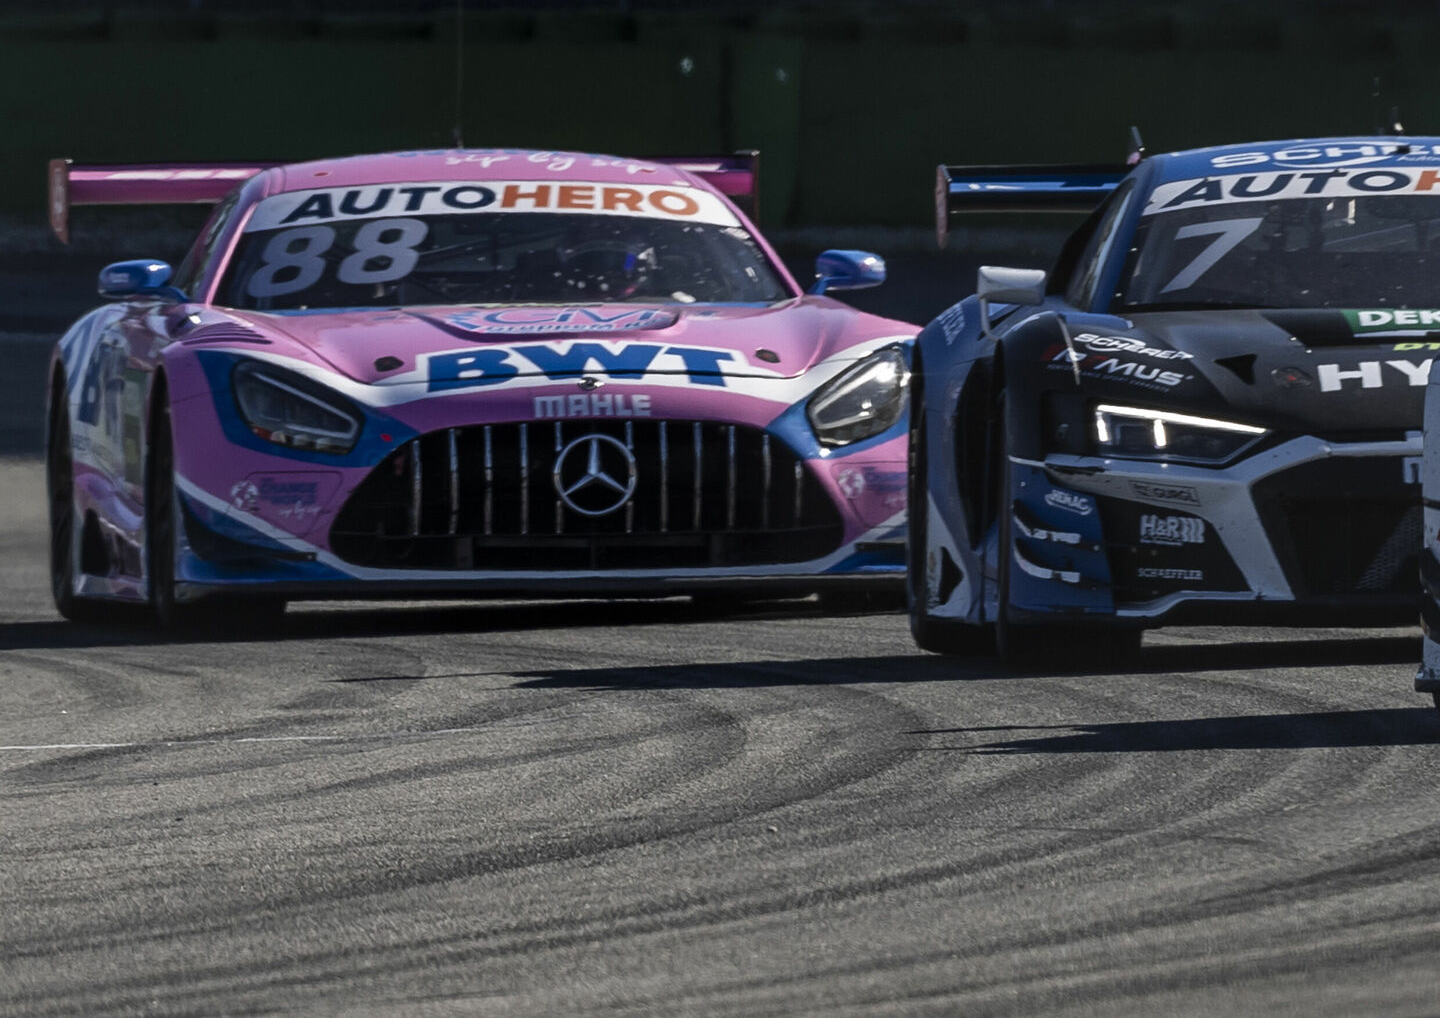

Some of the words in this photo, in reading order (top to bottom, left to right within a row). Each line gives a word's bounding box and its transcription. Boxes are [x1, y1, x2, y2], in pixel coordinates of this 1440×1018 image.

[282, 184, 700, 224] AUTOHERO
[248, 217, 429, 297] 88
[1159, 217, 1263, 294] 7
[1074, 333, 1195, 360] SCHERER
[427, 342, 735, 393] BWT
[533, 394, 651, 418] MAHLE
[1139, 513, 1181, 538] H&R
